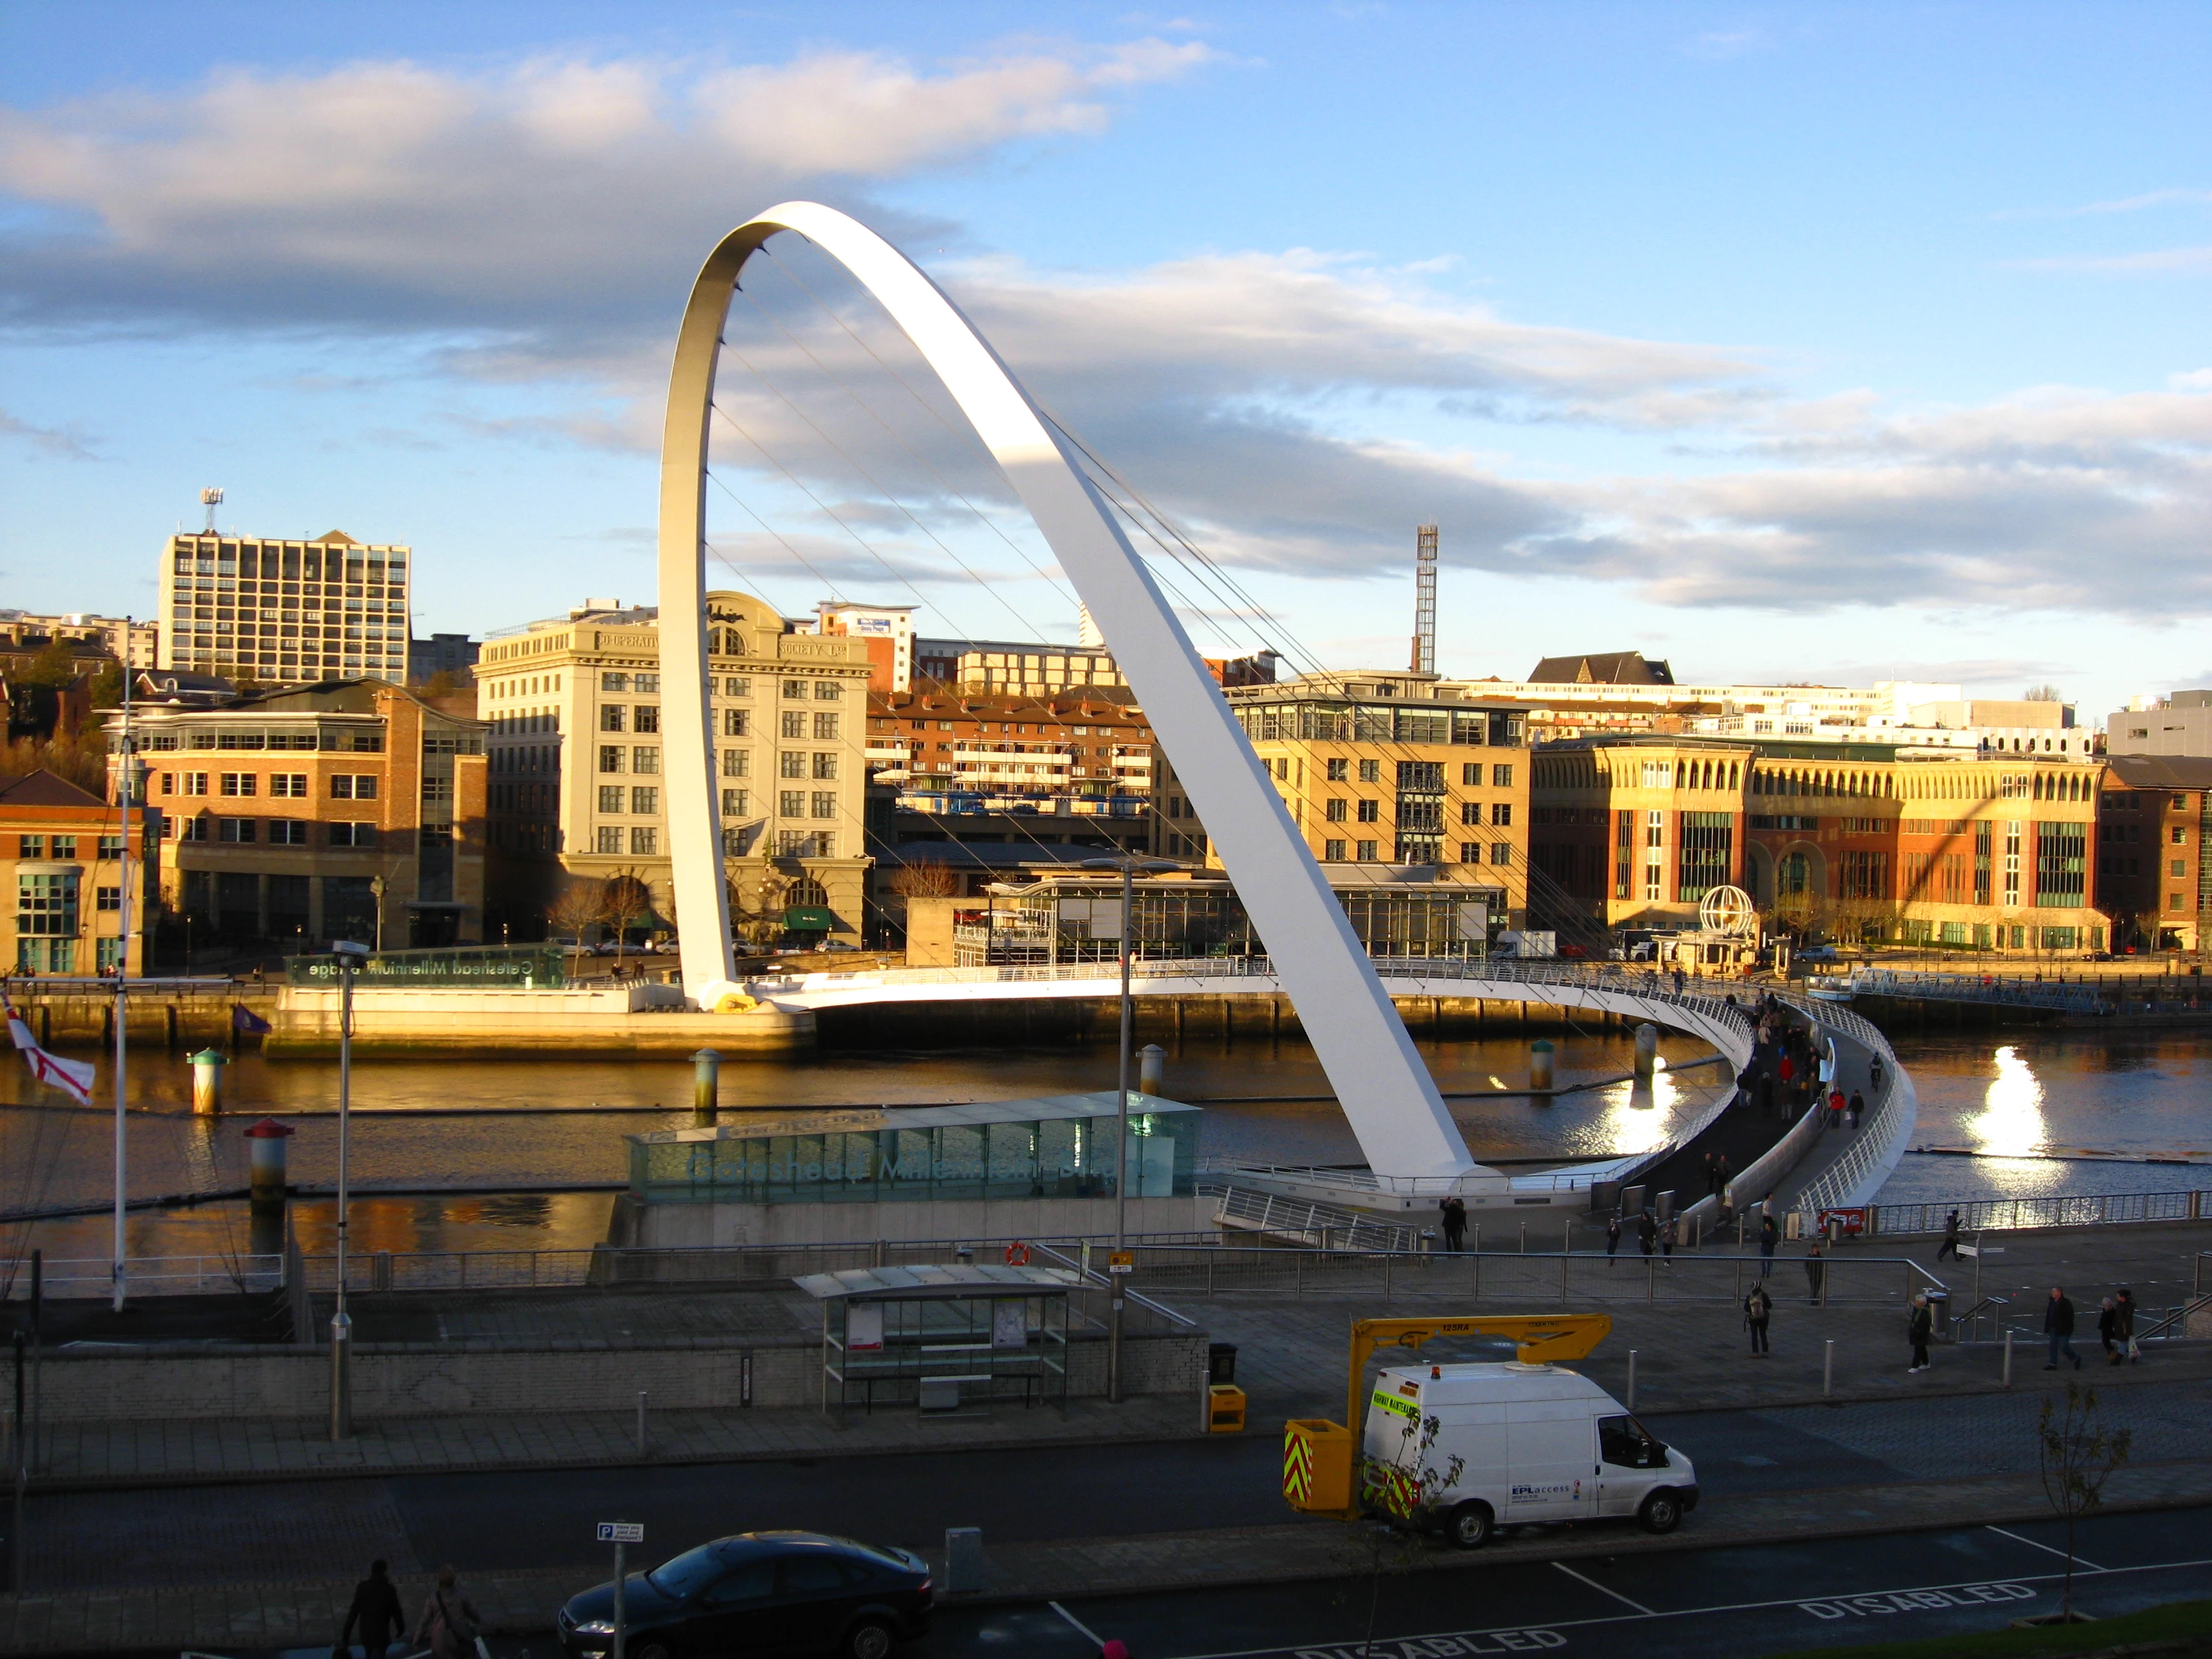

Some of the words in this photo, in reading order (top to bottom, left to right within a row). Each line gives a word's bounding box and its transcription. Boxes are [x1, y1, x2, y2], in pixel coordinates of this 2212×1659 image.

[779, 642, 821, 655] SOCIETY
[686, 1151, 864, 1183] Gateshead
[878, 1149, 1038, 1180] Millennium
[1442, 1324, 1469, 1332] 125RA
[1796, 1582, 2037, 1620] DISABLED
